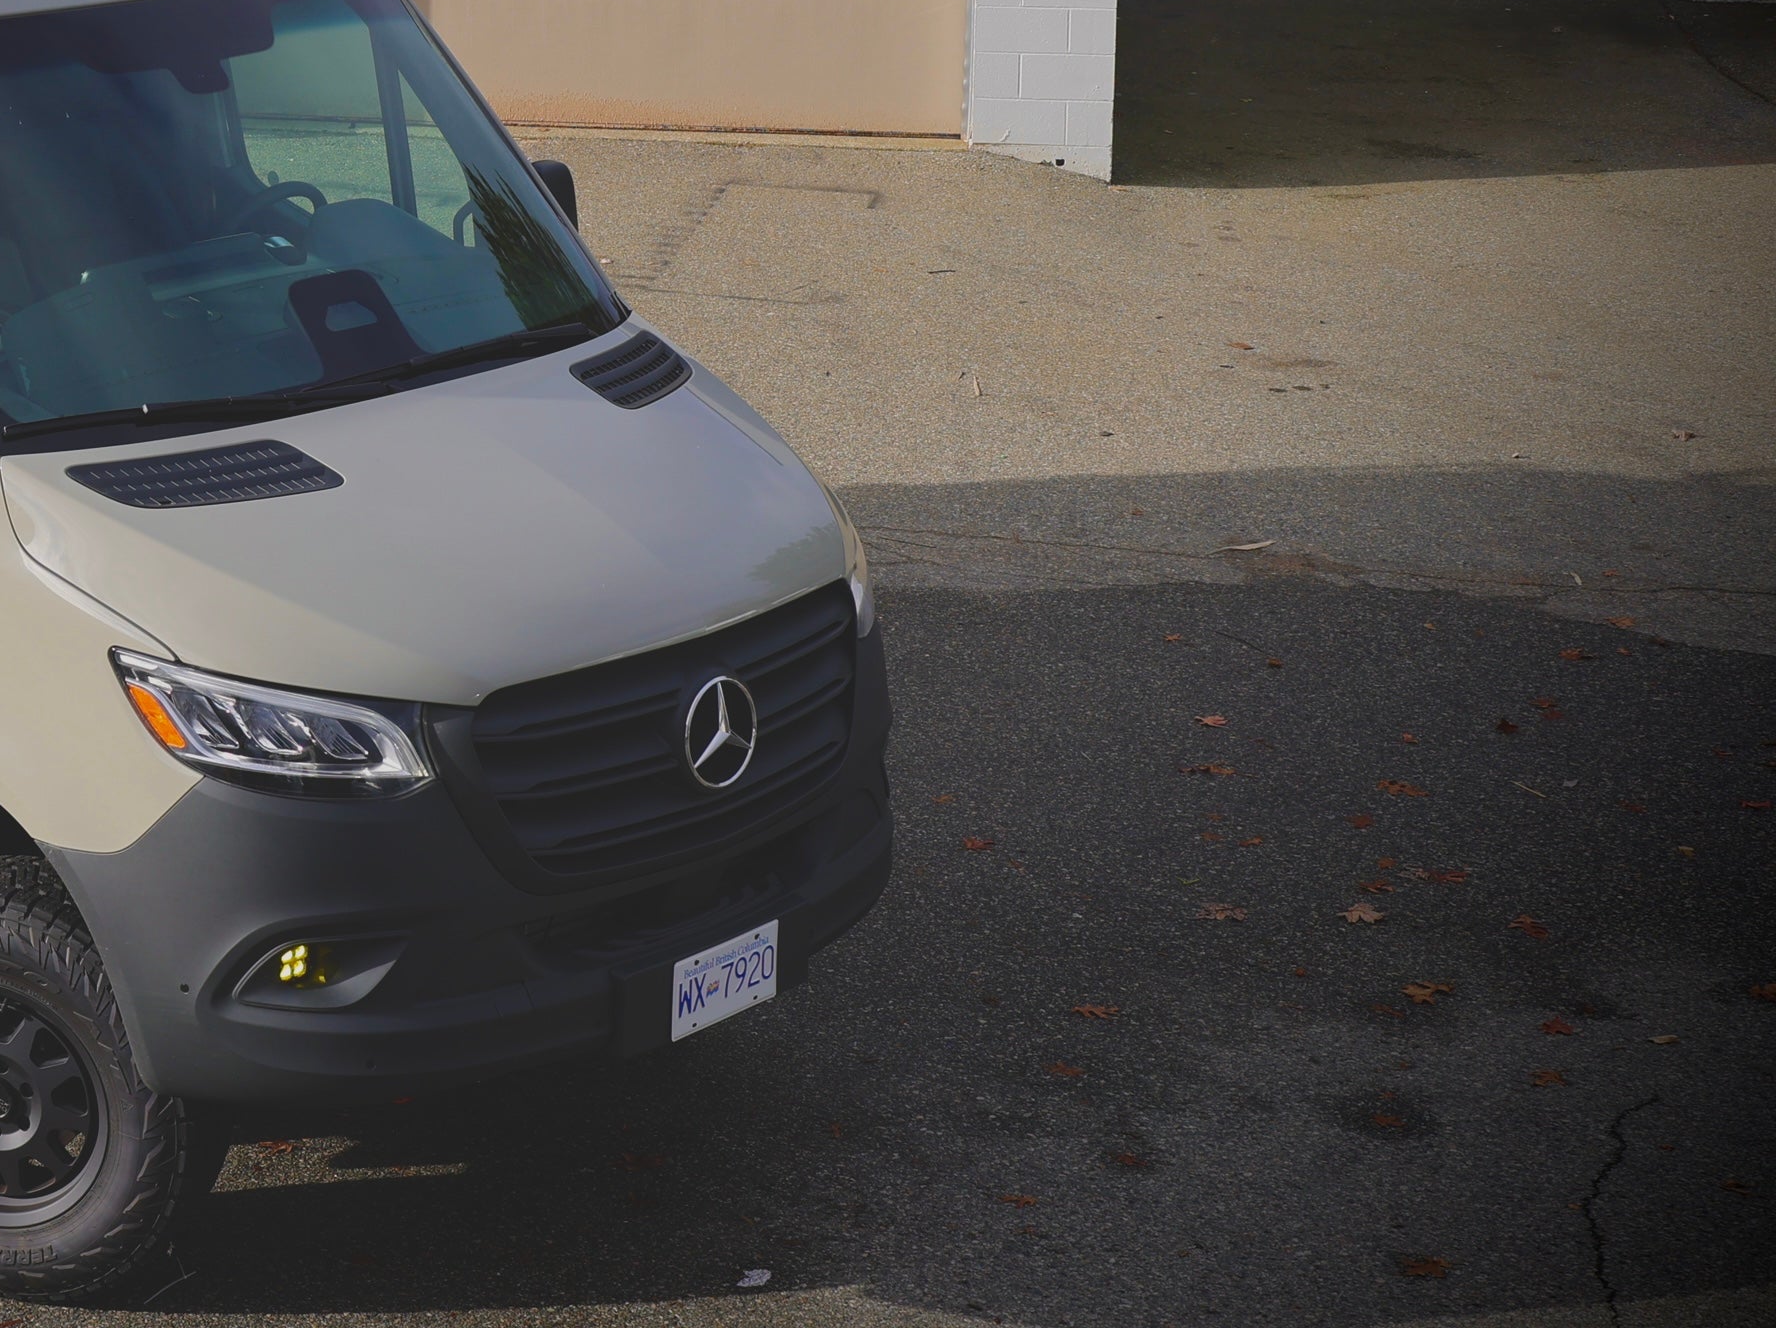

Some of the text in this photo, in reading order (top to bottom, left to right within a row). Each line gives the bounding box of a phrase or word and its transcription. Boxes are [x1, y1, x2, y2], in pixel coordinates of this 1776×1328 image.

[678, 944, 775, 1019] WX 7920
[684, 936, 770, 980] Beautiful British Columbia
